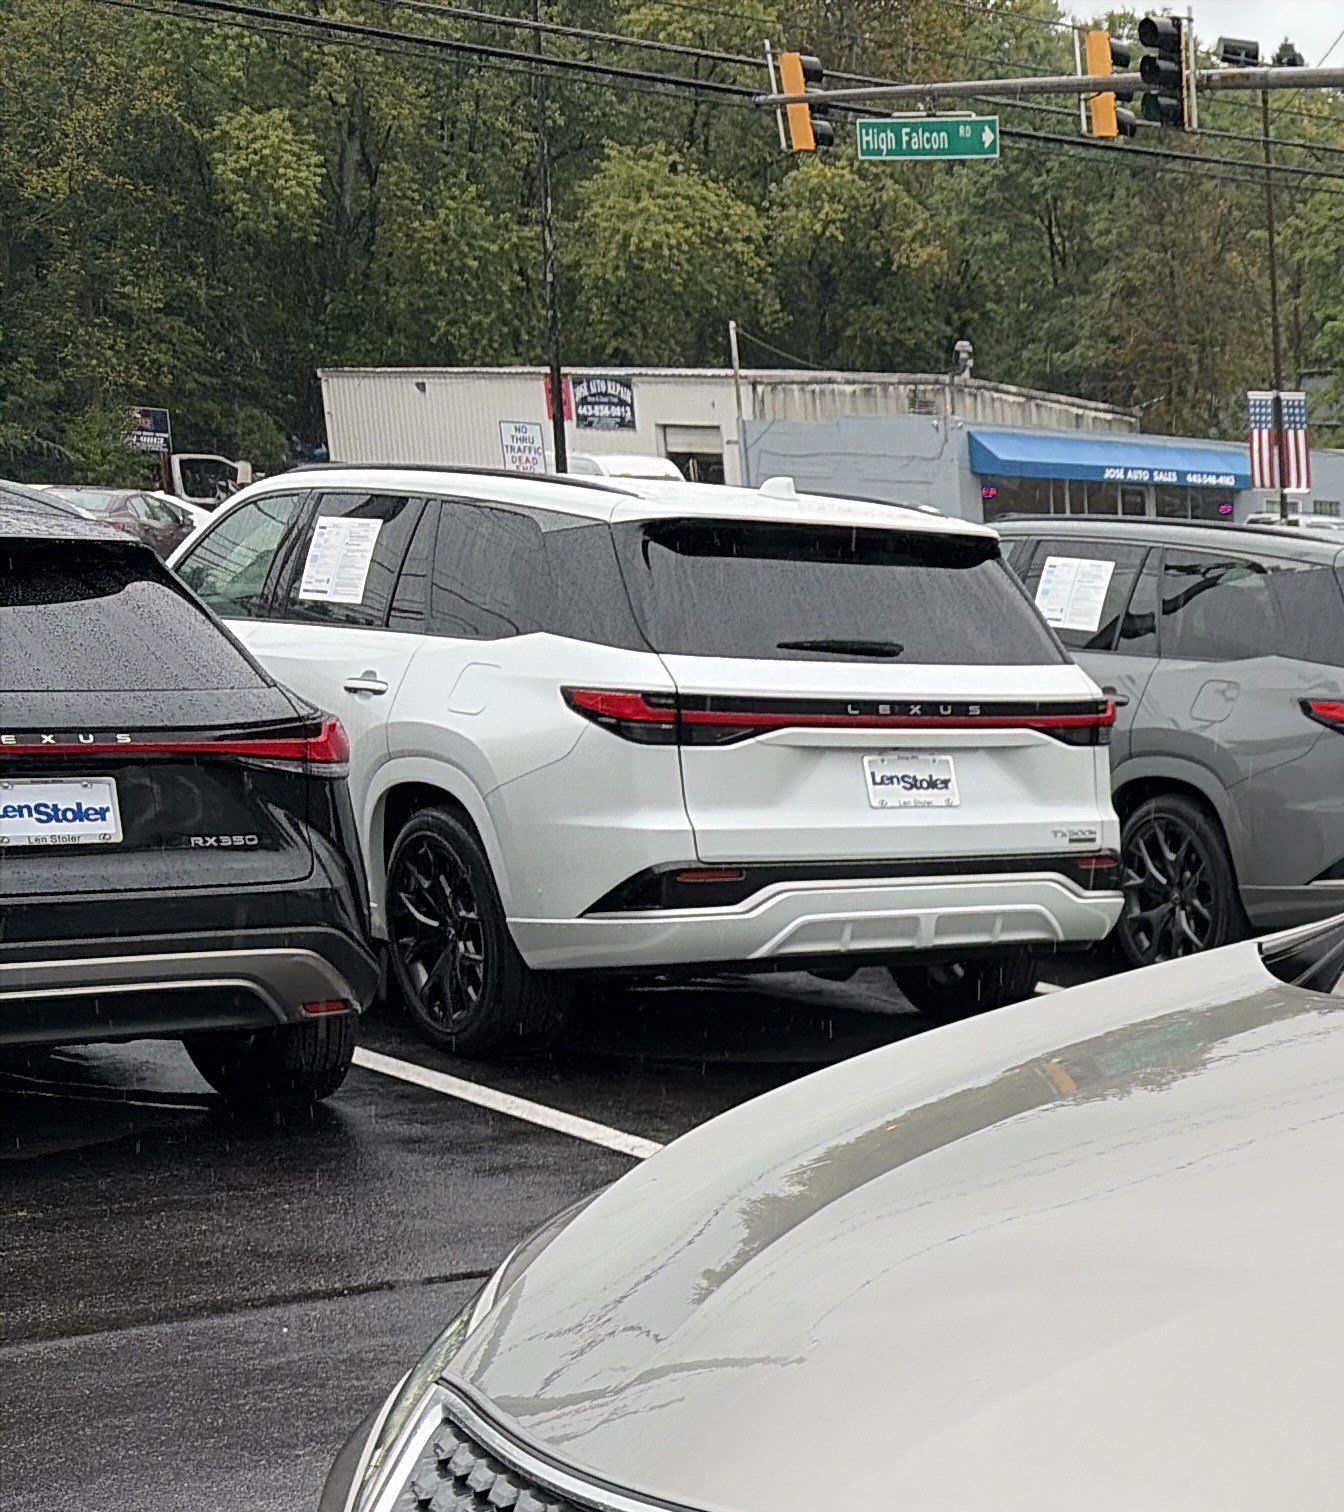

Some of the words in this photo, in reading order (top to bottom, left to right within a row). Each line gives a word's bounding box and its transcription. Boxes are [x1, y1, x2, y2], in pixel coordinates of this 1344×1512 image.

[861, 128, 896, 156] High
[901, 127, 949, 150] Falcon
[958, 125, 972, 138] RD
[513, 425, 528, 435] NO
[510, 434, 535, 445] THRU
[504, 444, 542, 456] TRAFFIC
[511, 454, 539, 466] DEAD
[1126, 469, 1150, 481] AUTO
[1153, 470, 1178, 483] SALES
[847, 704, 981, 716] LEXUS
[0, 733, 132, 745] EXUS
[27, 835, 48, 844] Len
[50, 833, 82, 844] Stoler
